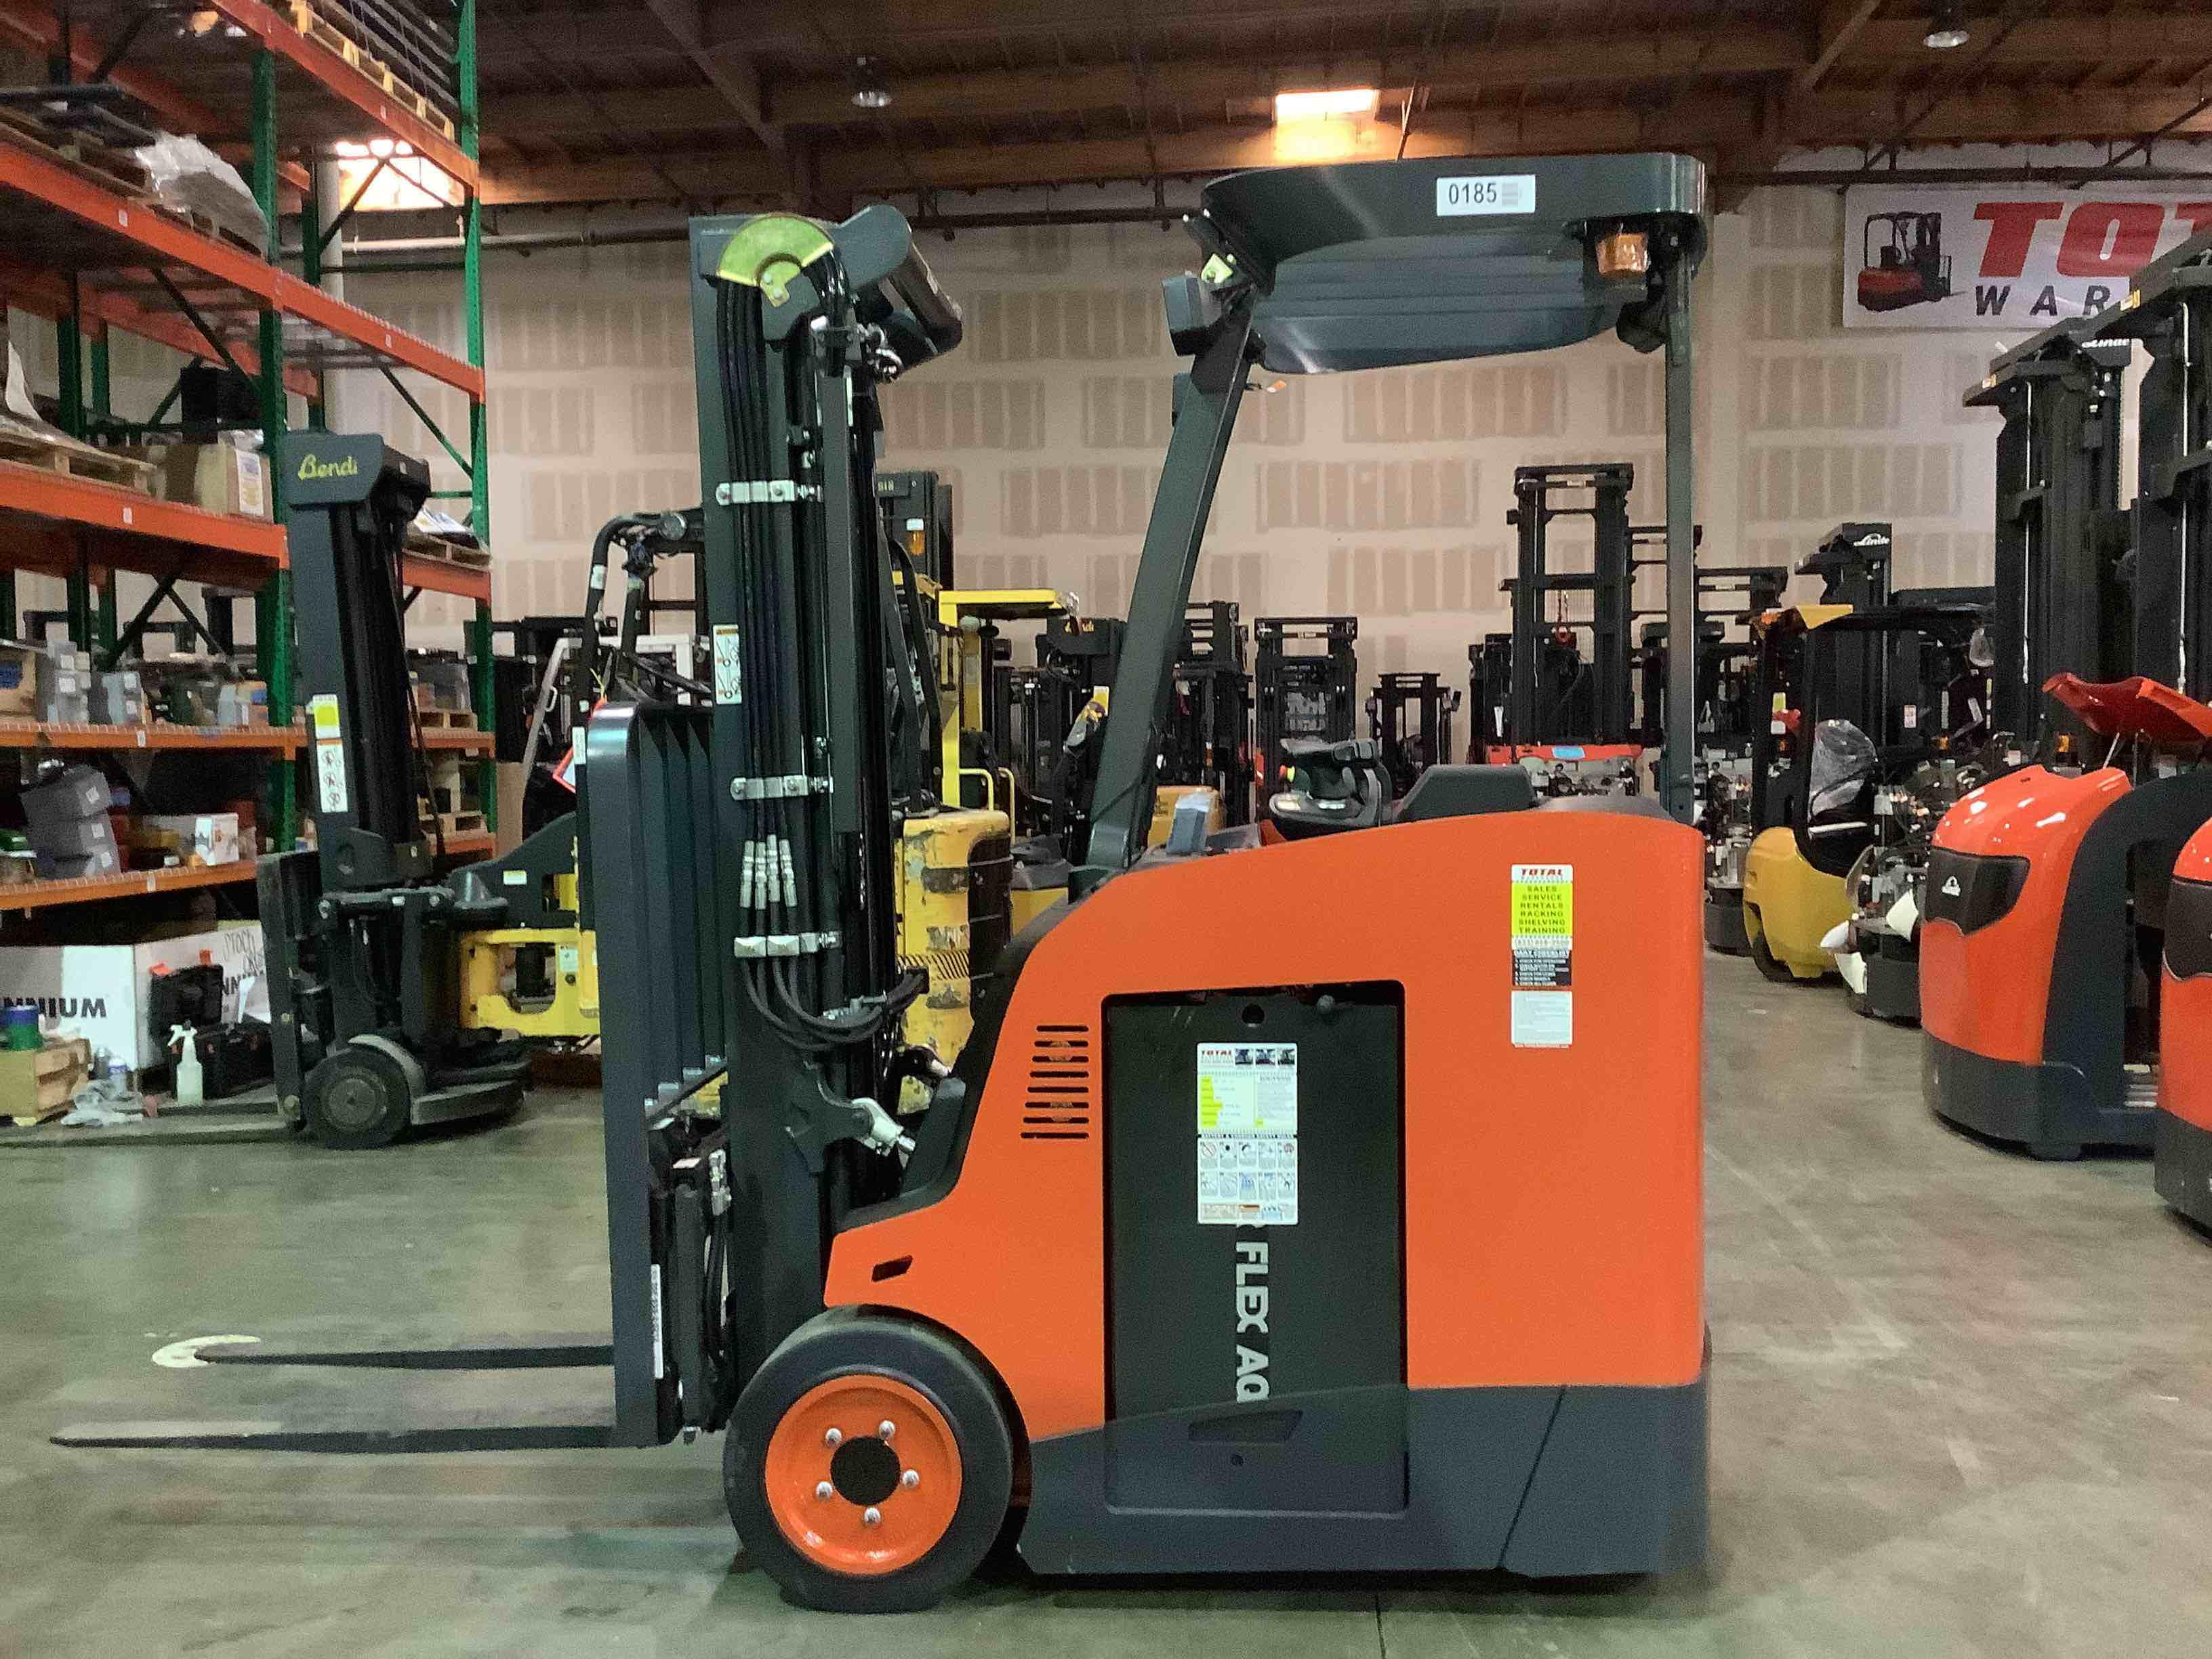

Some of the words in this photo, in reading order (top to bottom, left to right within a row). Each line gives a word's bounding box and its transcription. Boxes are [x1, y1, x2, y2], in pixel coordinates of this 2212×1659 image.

[1448, 183, 1497, 204] 0185
[298, 454, 358, 480] Bendi
[1235, 1242, 1269, 1333] FLEX
